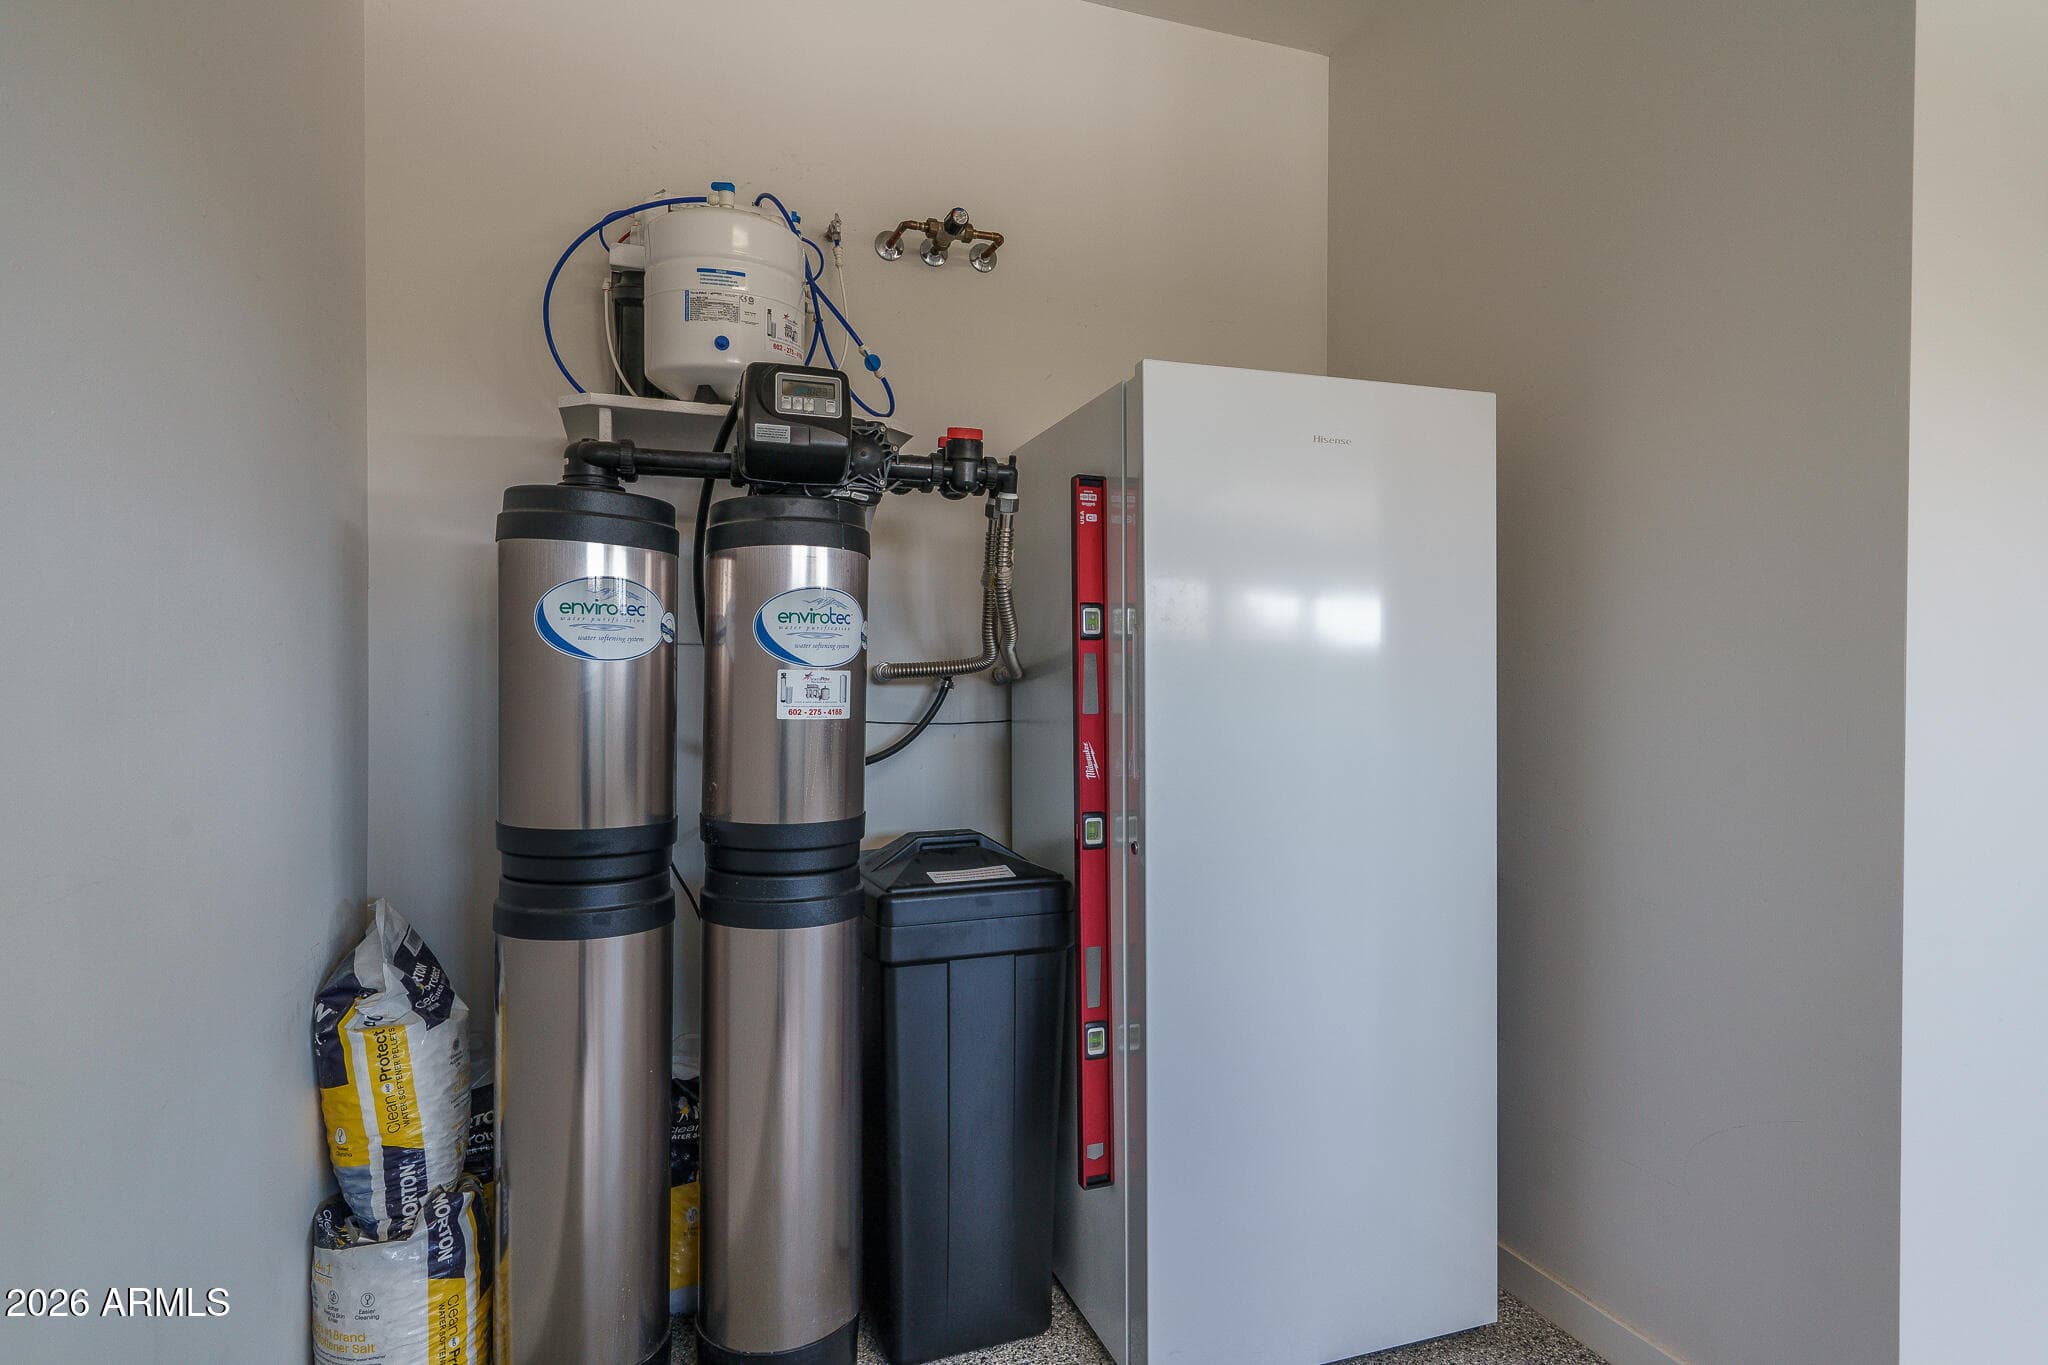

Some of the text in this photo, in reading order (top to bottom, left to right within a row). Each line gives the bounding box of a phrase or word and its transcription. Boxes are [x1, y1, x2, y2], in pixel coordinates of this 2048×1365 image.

[1312, 435, 1352, 445] Hisense
[778, 607, 851, 624] envirotec
[1082, 742, 1097, 780] Milwaukee
[374, 1029, 392, 1083] Protect
[394, 1061, 406, 1100] SOFTENER
[385, 1094, 401, 1134] Clean
[400, 1101, 410, 1127] WATER
[400, 1164, 419, 1231] MORTON
[432, 1193, 454, 1262] MORTON
[448, 1294, 460, 1336] Clean
[334, 1329, 366, 1342] Brand
[352, 1344, 376, 1354] Salt
